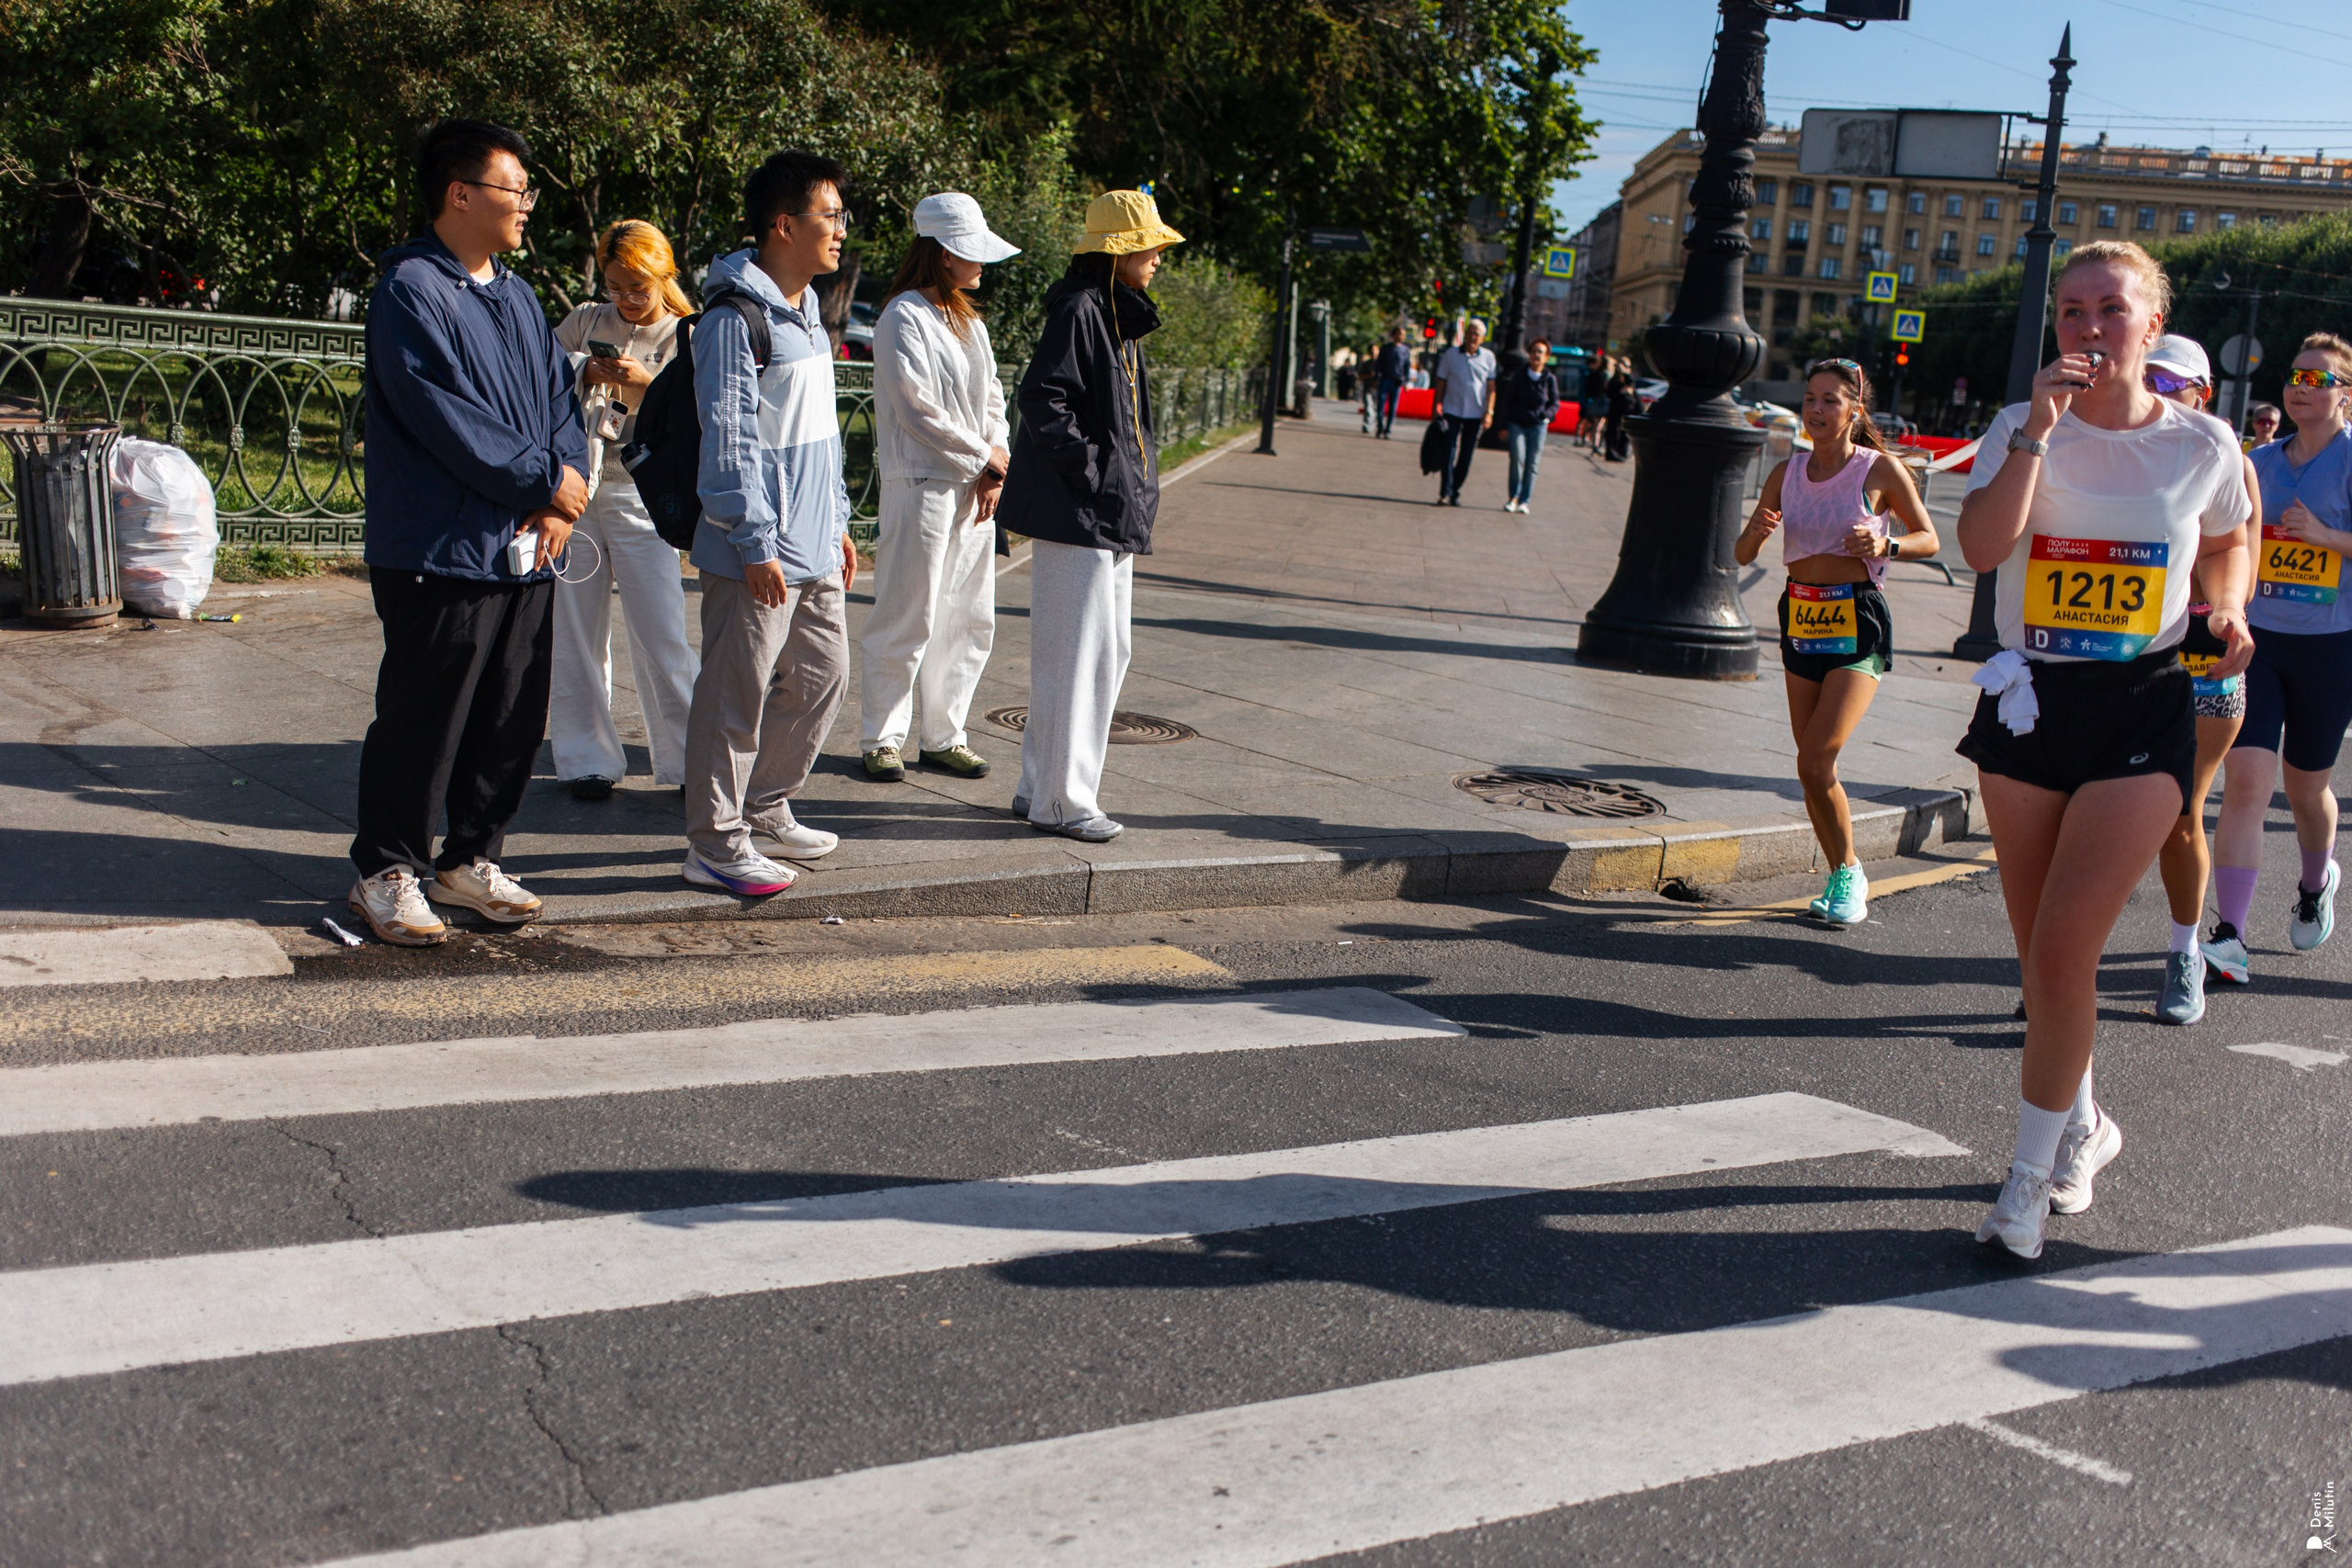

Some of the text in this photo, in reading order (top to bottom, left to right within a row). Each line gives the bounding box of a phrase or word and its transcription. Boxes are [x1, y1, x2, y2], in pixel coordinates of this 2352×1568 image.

[2048, 539, 2070, 547] ПОЛУ
[2047, 547, 2089, 555] МАРАФОН
[2109, 547, 2129, 559] 21,1
[2269, 547, 2328, 574] 6421
[2274, 570, 2320, 582] АНАСТАСИЯ
[2047, 570, 2146, 612] 1213
[2263, 582, 2272, 596] D
[1795, 604, 1846, 627] 6444
[2053, 610, 2130, 626] АНАСТАСИЯ
[2035, 629, 2049, 649] D
